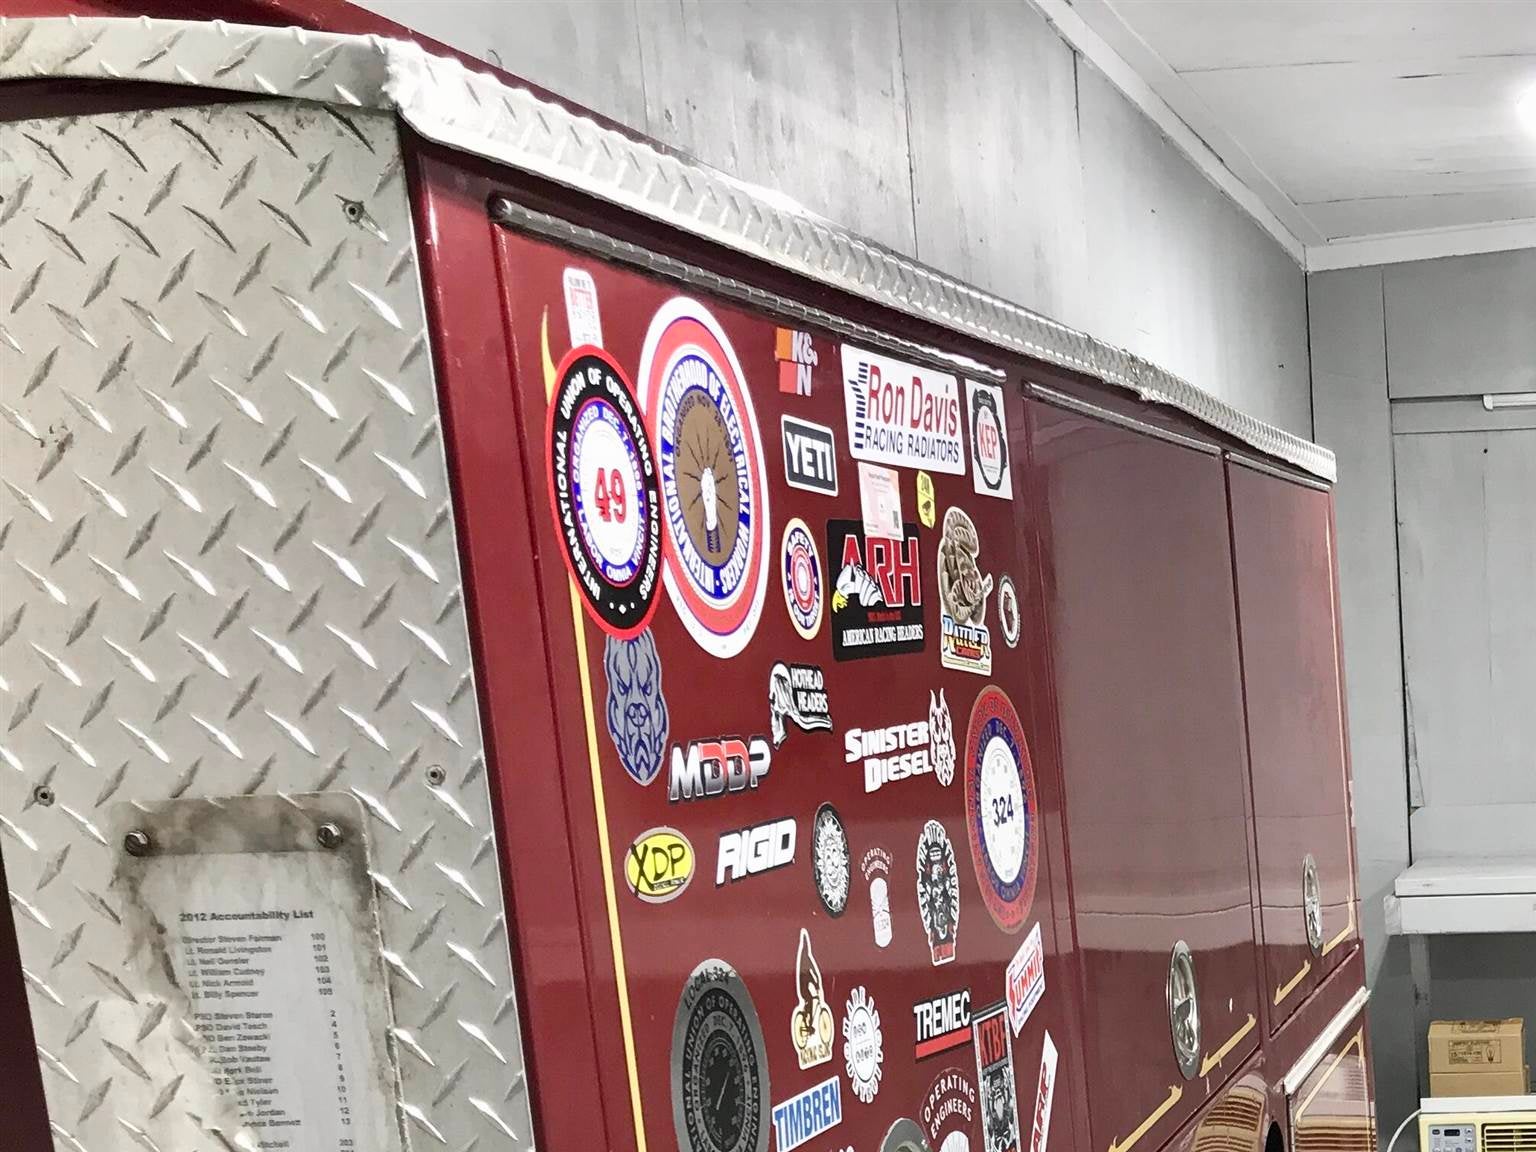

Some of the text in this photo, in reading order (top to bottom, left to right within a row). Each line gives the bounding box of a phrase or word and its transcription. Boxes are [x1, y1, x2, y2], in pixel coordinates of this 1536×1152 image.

[560, 371, 586, 420] UNION
[587, 367, 602, 385] OF
[866, 365, 958, 438] Ron Davis
[605, 376, 653, 476] OPERATING
[864, 426, 960, 464] RACING RADIATORS
[661, 359, 750, 595] INTERNATIONAL BROTHERHOOD OF ELECTRICAL WORKERS
[785, 430, 834, 483] YETI
[556, 431, 601, 600] INTERNATIONAL
[595, 467, 628, 524] 49
[639, 490, 659, 600] ENGINEERS
[842, 535, 922, 608] ARH
[842, 623, 924, 647] AMERICAN RACING HEADERS
[797, 690, 829, 713] HEADERS
[844, 720, 930, 764] SINISTER
[864, 749, 933, 794] DIESEL
[992, 794, 1015, 827] 324
[631, 843, 685, 897] XDP
[715, 818, 797, 886] RIGID
[179, 910, 314, 922] 2012 Accountability List
[684, 967, 712, 1010] LOCAL
[1008, 944, 1042, 1021] SUMMIT
[330, 1009, 336, 1017] 2
[331, 1020, 337, 1028] 4
[686, 1007, 705, 1060] UNION
[705, 996, 716, 1010] OF
[913, 990, 971, 1043] TREMEC
[774, 1080, 841, 1152] TIMBREN
[924, 1074, 976, 1123] OPERATING
[930, 1098, 972, 1140] ENGINEERS
